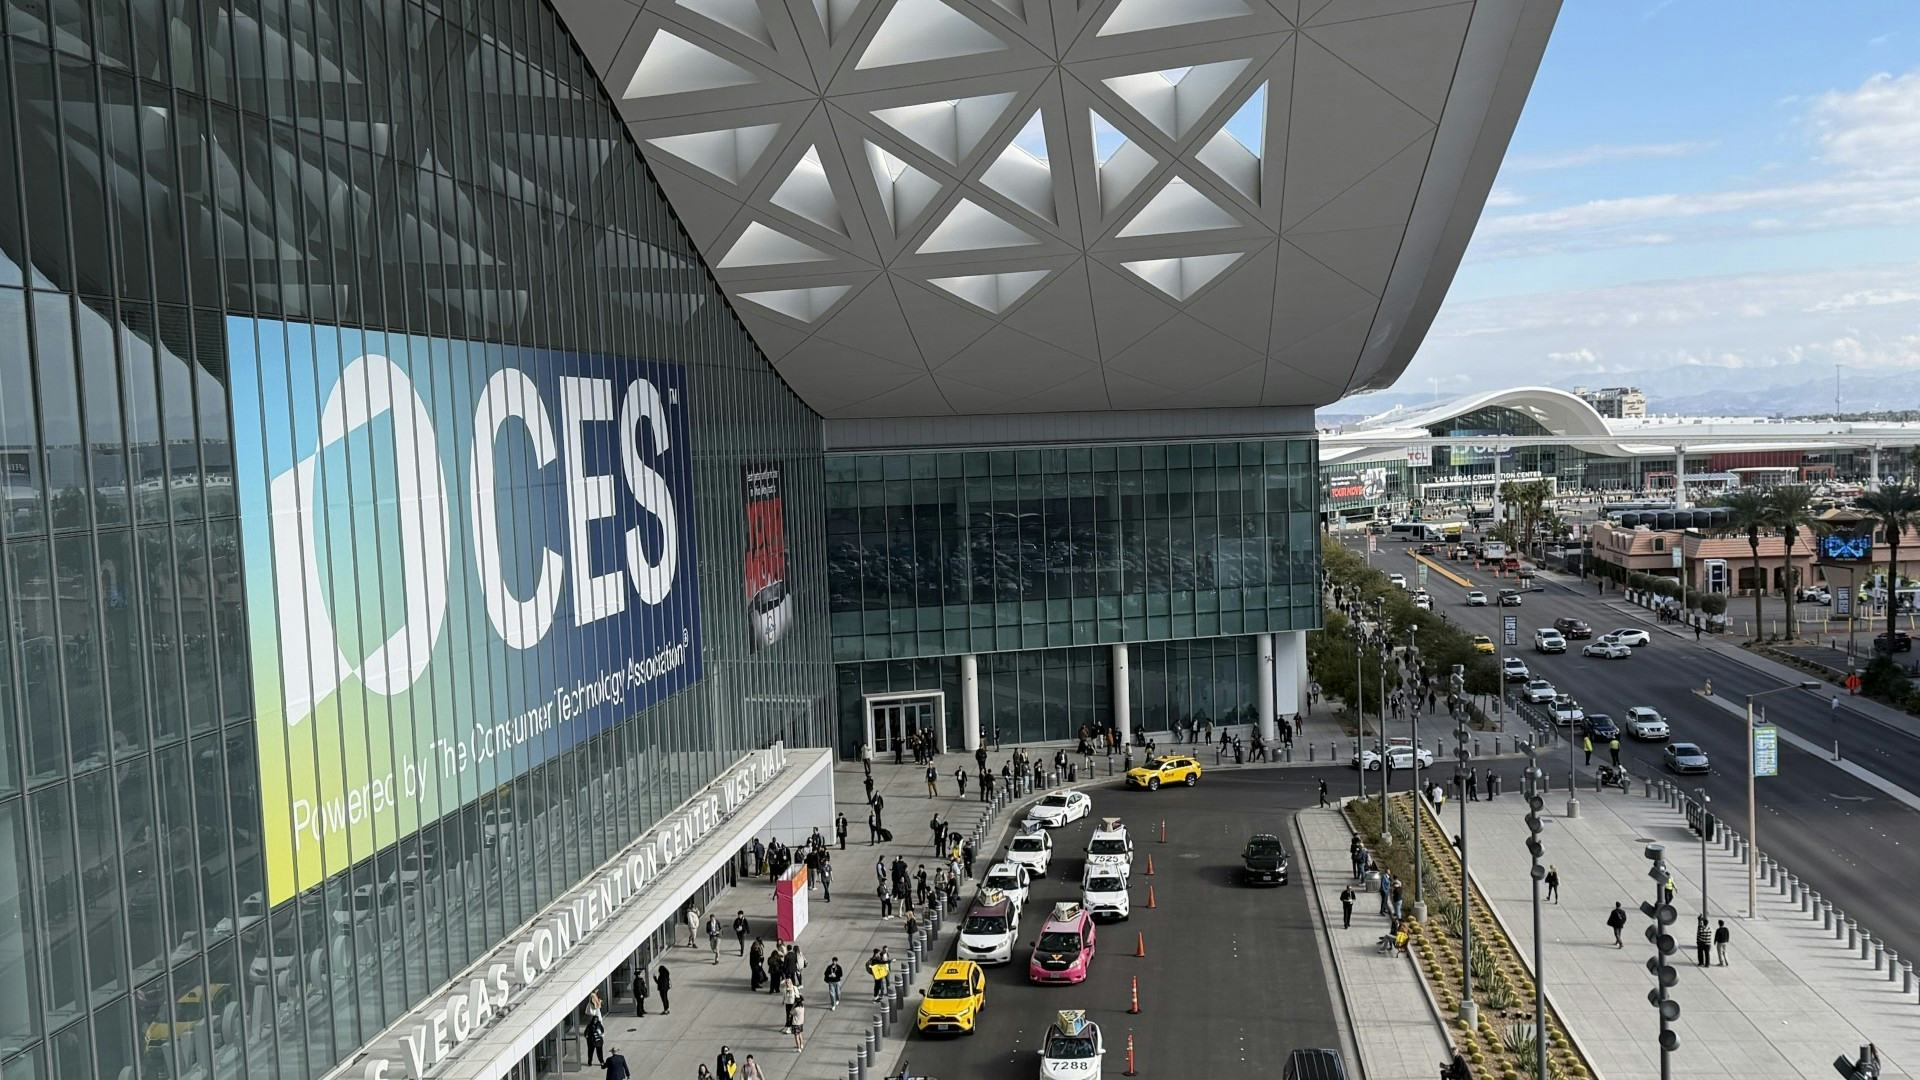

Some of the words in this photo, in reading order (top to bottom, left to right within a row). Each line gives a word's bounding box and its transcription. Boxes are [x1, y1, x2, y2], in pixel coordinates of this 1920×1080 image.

[1407, 452, 1428, 460] TCL
[1434, 475, 1448, 483] LAS
[1449, 474, 1472, 482] VEGAS
[1473, 472, 1516, 481] CONVETION
[1516, 471, 1542, 479] CENTER
[403, 755, 427, 803] by
[471, 700, 553, 764] Consumer
[1094, 855, 1119, 863] 7525
[399, 963, 509, 1080] VEGAS
[515, 842, 658, 984] CONVENTION
[657, 794, 720, 864] CENTER
[720, 765, 758, 813] WEST
[758, 740, 787, 784] HALL
[1052, 1061, 1088, 1071] 7288
